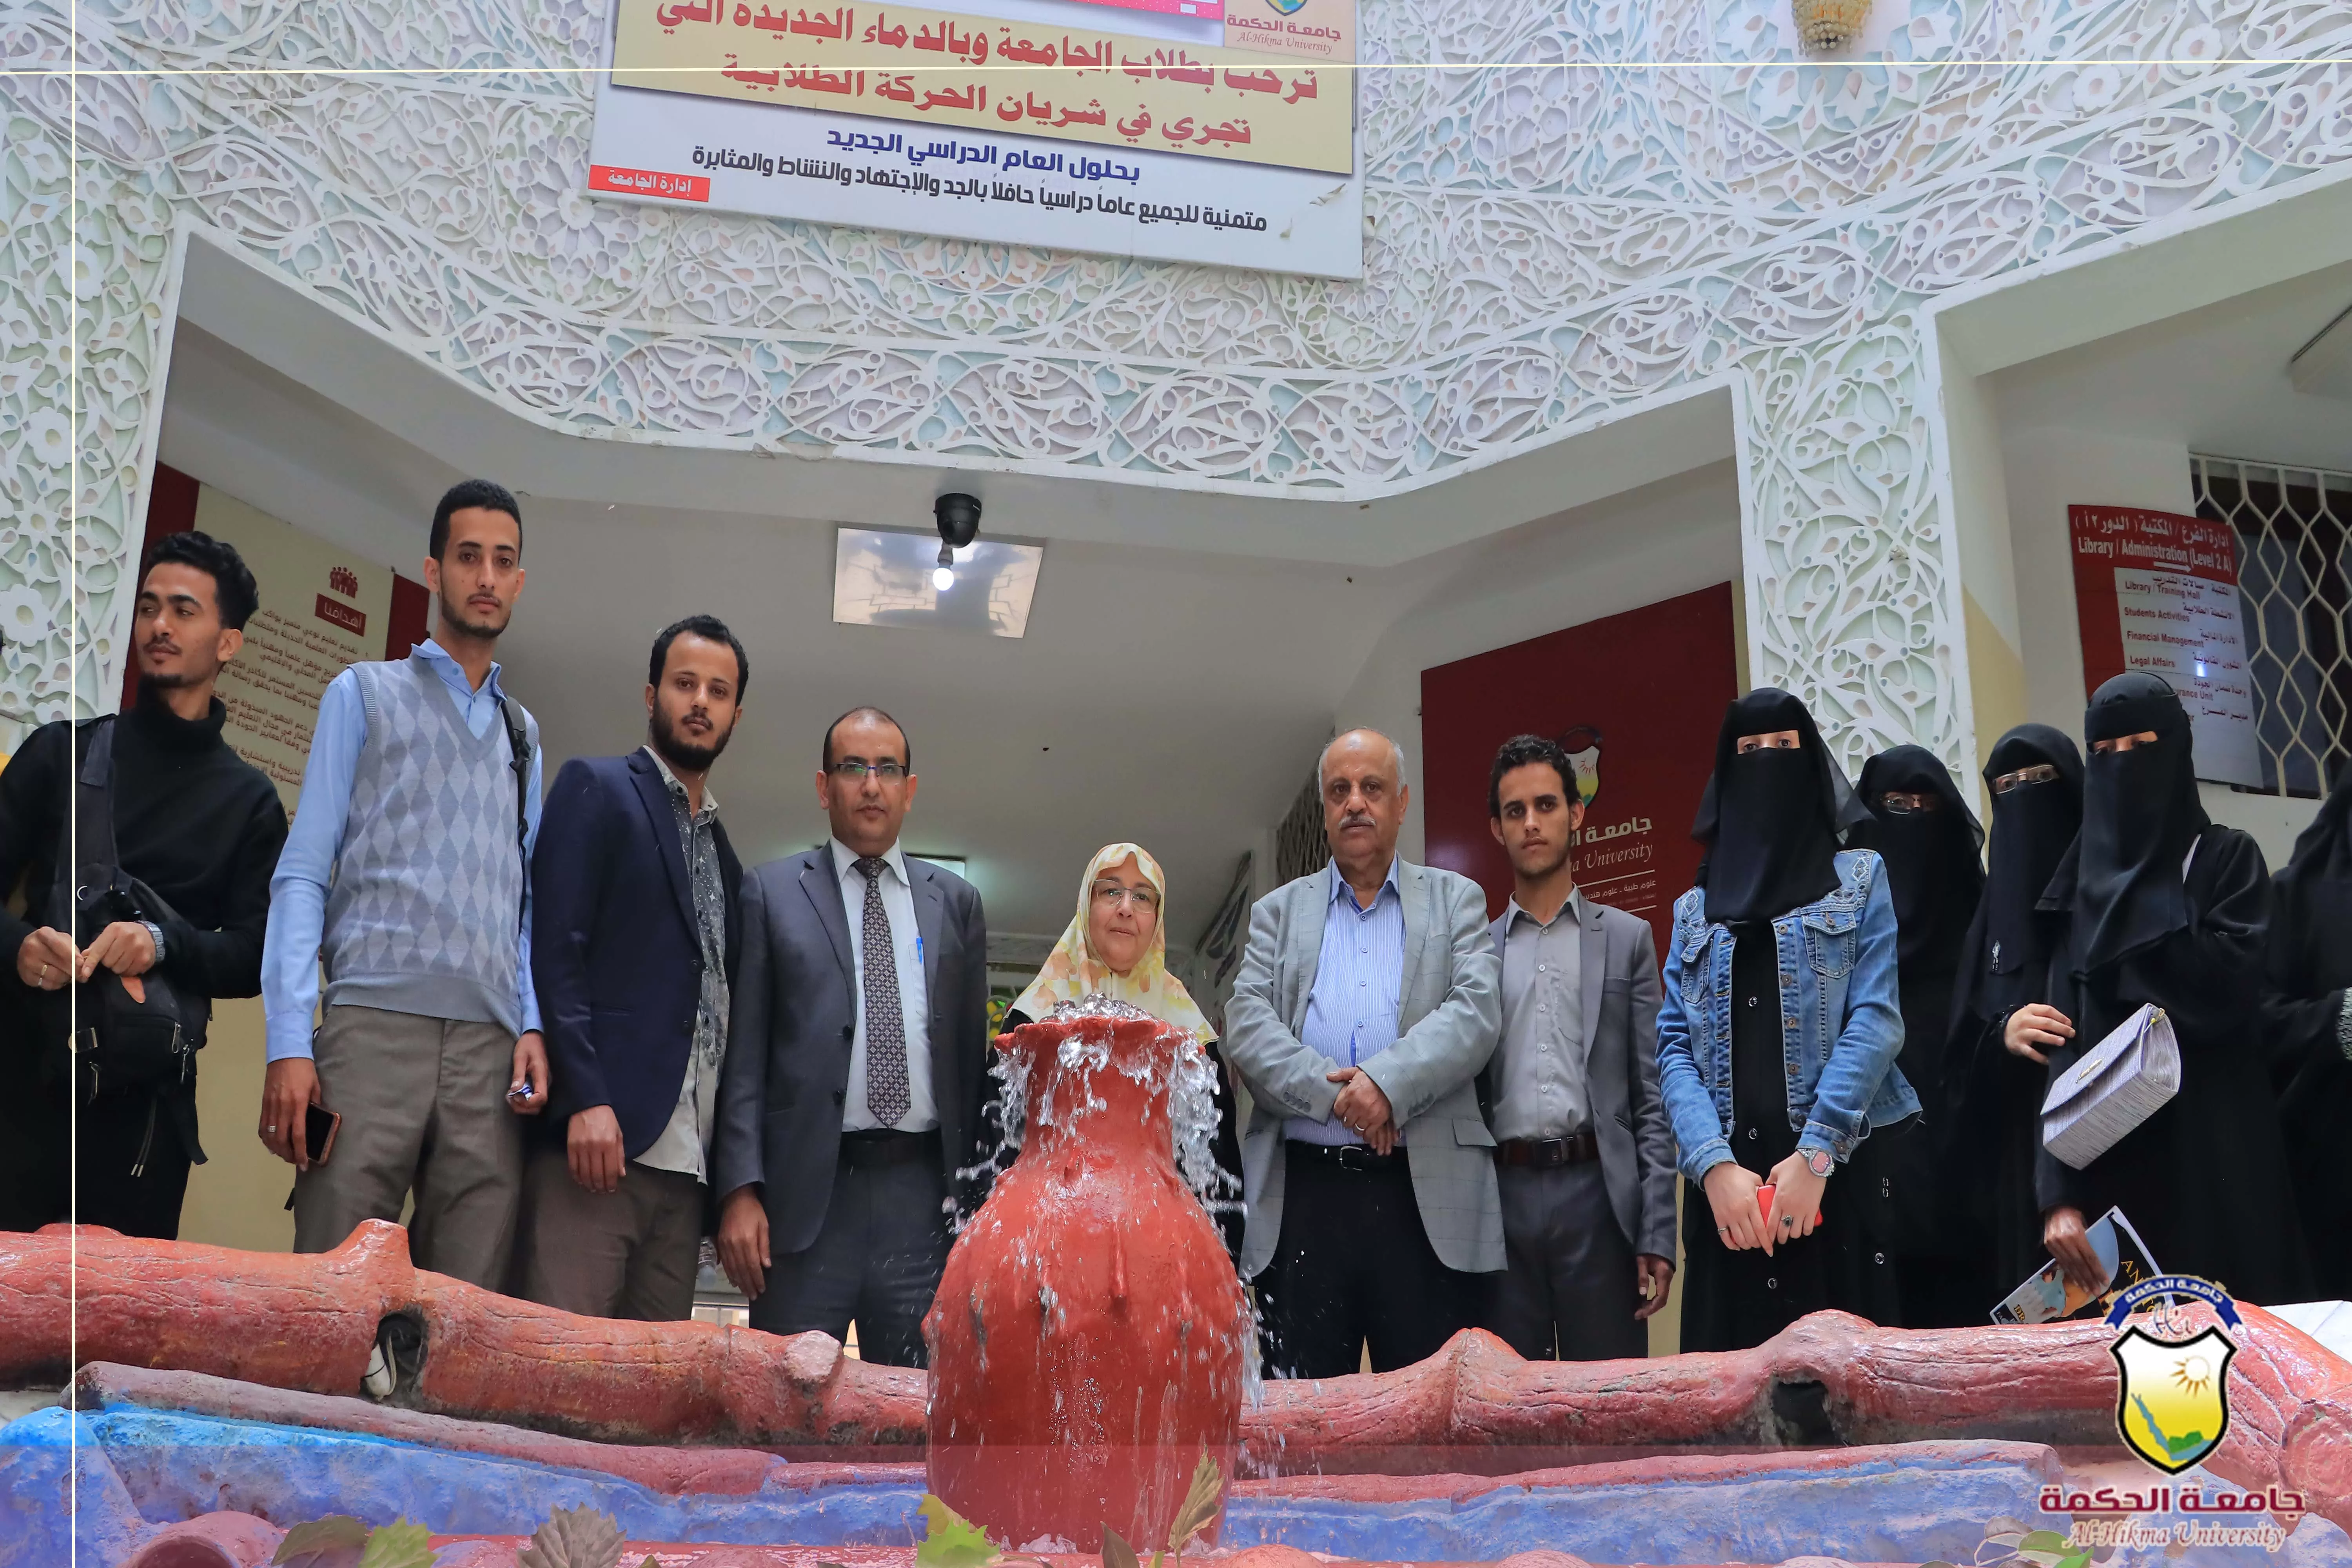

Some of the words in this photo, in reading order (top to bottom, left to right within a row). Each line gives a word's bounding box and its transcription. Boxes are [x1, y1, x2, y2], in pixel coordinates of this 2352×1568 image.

[1227, 14, 1283, 32] الحكمة
[1287, 19, 1341, 41] جامعة
[996, 26, 1112, 77] الجامعة
[1237, 32, 1282, 46] Al-Hikma
[1285, 37, 1332, 54] University
[721, 53, 865, 97] الطلابية
[1121, 48, 1214, 94] بطلاب
[875, 72, 986, 112] الحركة
[1223, 66, 1317, 105] ترحب
[997, 91, 1106, 127] شريان
[1117, 103, 1152, 143] في
[1161, 117, 1251, 149] تجري
[827, 129, 902, 154] الجديد
[907, 141, 997, 166] الدراسي
[692, 145, 773, 176] والمثابرة
[777, 156, 852, 186] والنشاط
[1002, 150, 1063, 172] العام
[1069, 156, 1140, 185] بحلول
[608, 169, 657, 191] الجامعة
[659, 176, 692, 198] إدارة
[855, 166, 940, 196] والإجتهاد
[944, 178, 988, 202] بالجد
[1138, 202, 1199, 225] للجميع
[1202, 207, 1267, 231] متمنية
[2139, 514, 2172, 537] المكتبة
[2078, 537, 2113, 558] Library
[2122, 539, 2188, 563] Administration
[2190, 551, 2214, 568] (Level
[2216, 556, 2222, 570] 2
[2125, 581, 2151, 594] Library
[2156, 584, 2185, 599] Training
[2187, 590, 2200, 599] Hall
[325, 602, 362, 629] أهدافنا
[2124, 607, 2156, 618] Students
[2157, 610, 2190, 622] Activities
[2127, 631, 2160, 642] Financial
[2161, 633, 2204, 648] Management
[2130, 655, 2150, 667] Legal
[2152, 657, 2176, 668] Affairs
[2200, 690, 2214, 701] Unit
[1585, 817, 1653, 844] جامعة
[1584, 842, 1653, 869] University
[1602, 887, 1618, 897] علوم
[1624, 883, 1639, 892] طبية
[1640, 879, 1657, 890] علوم
